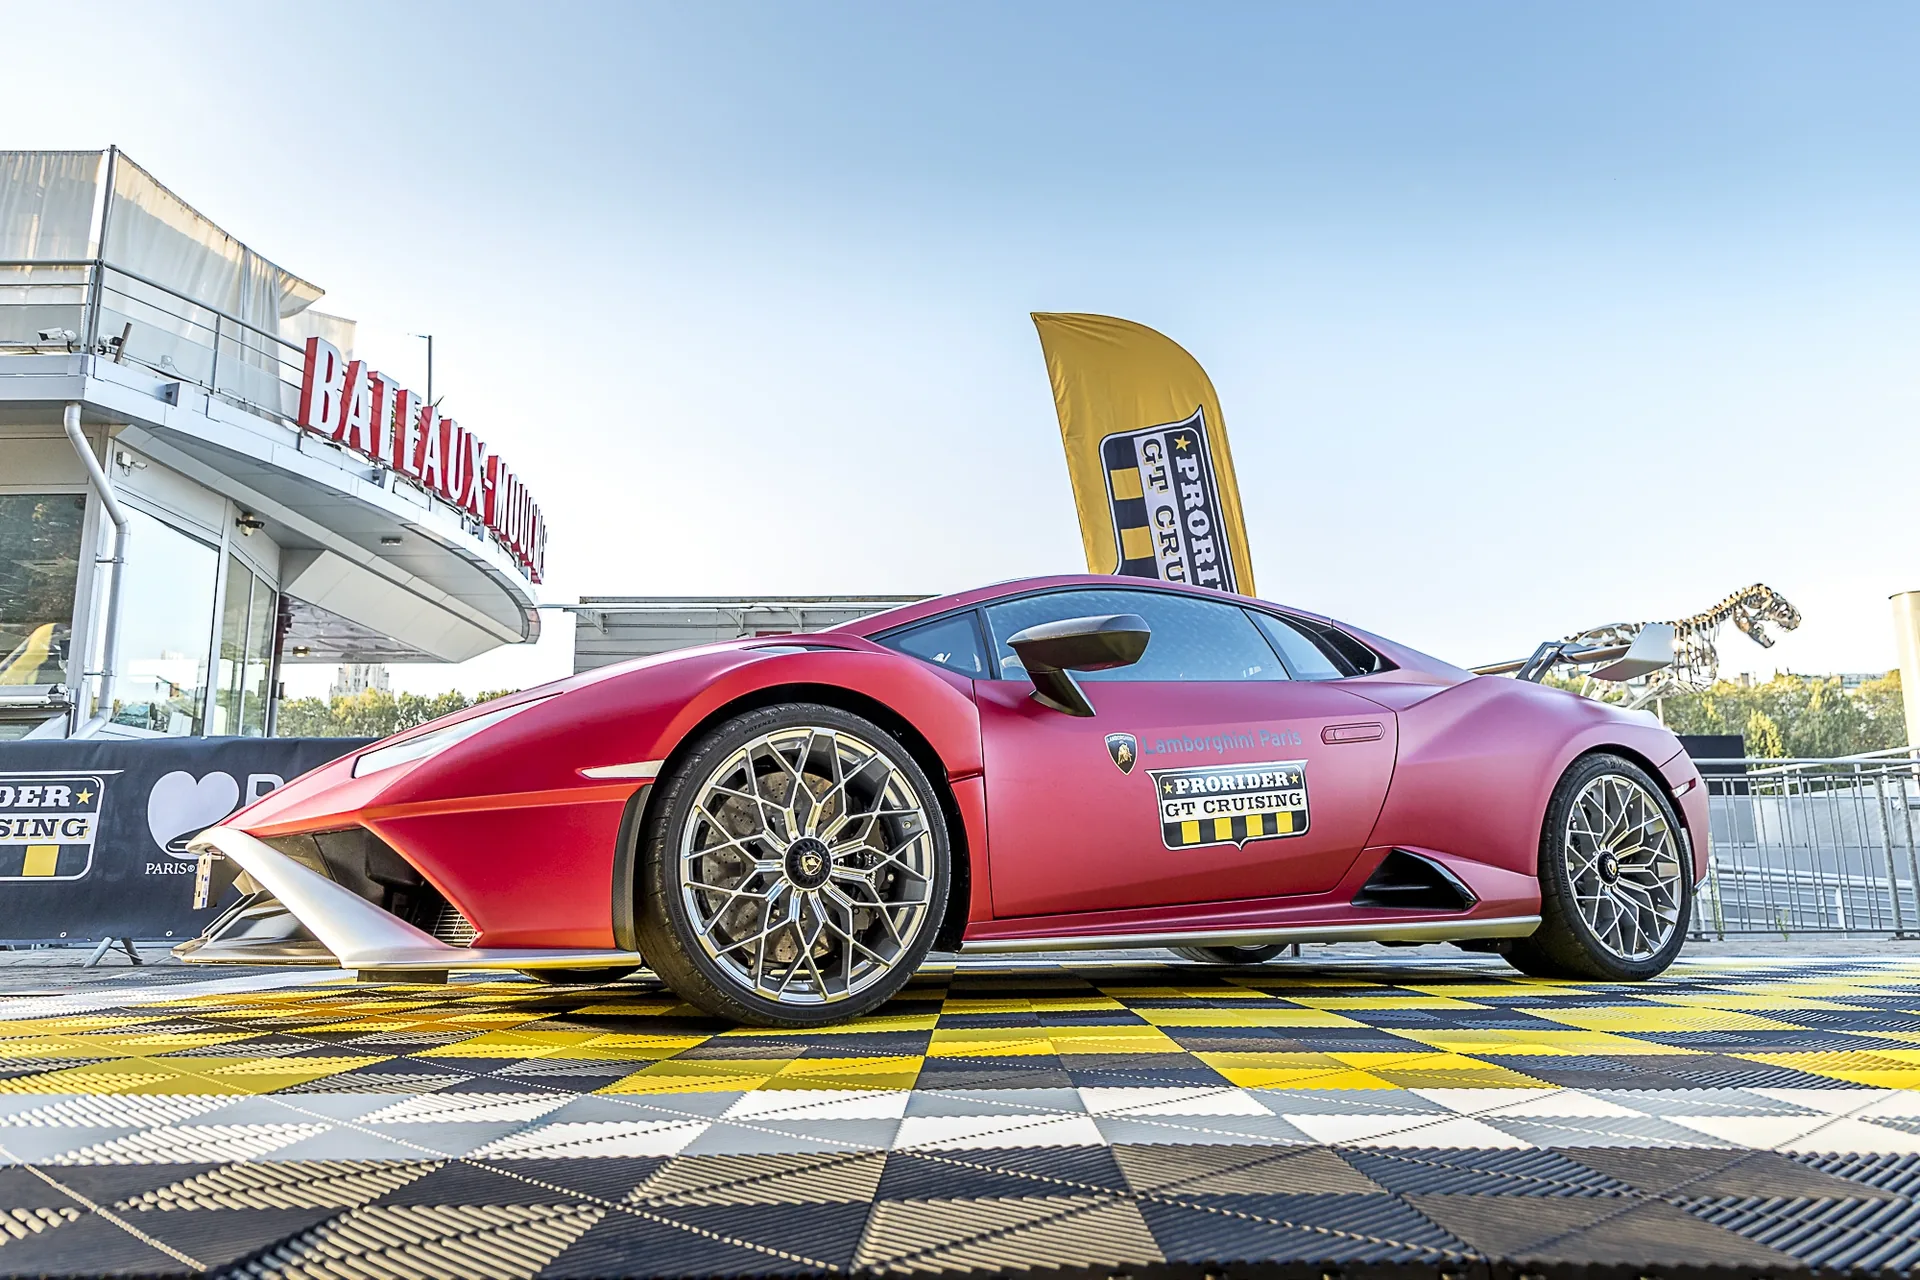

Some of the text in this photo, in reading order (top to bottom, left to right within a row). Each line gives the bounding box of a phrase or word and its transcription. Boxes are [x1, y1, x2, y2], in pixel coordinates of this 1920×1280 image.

[1143, 438, 1169, 493] GT
[1176, 454, 1222, 591] PRORI
[1142, 728, 1303, 754] Lamborghini Paris
[1173, 771, 1290, 795] PRORIDER
[1165, 793, 1303, 817] GT CRUISING
